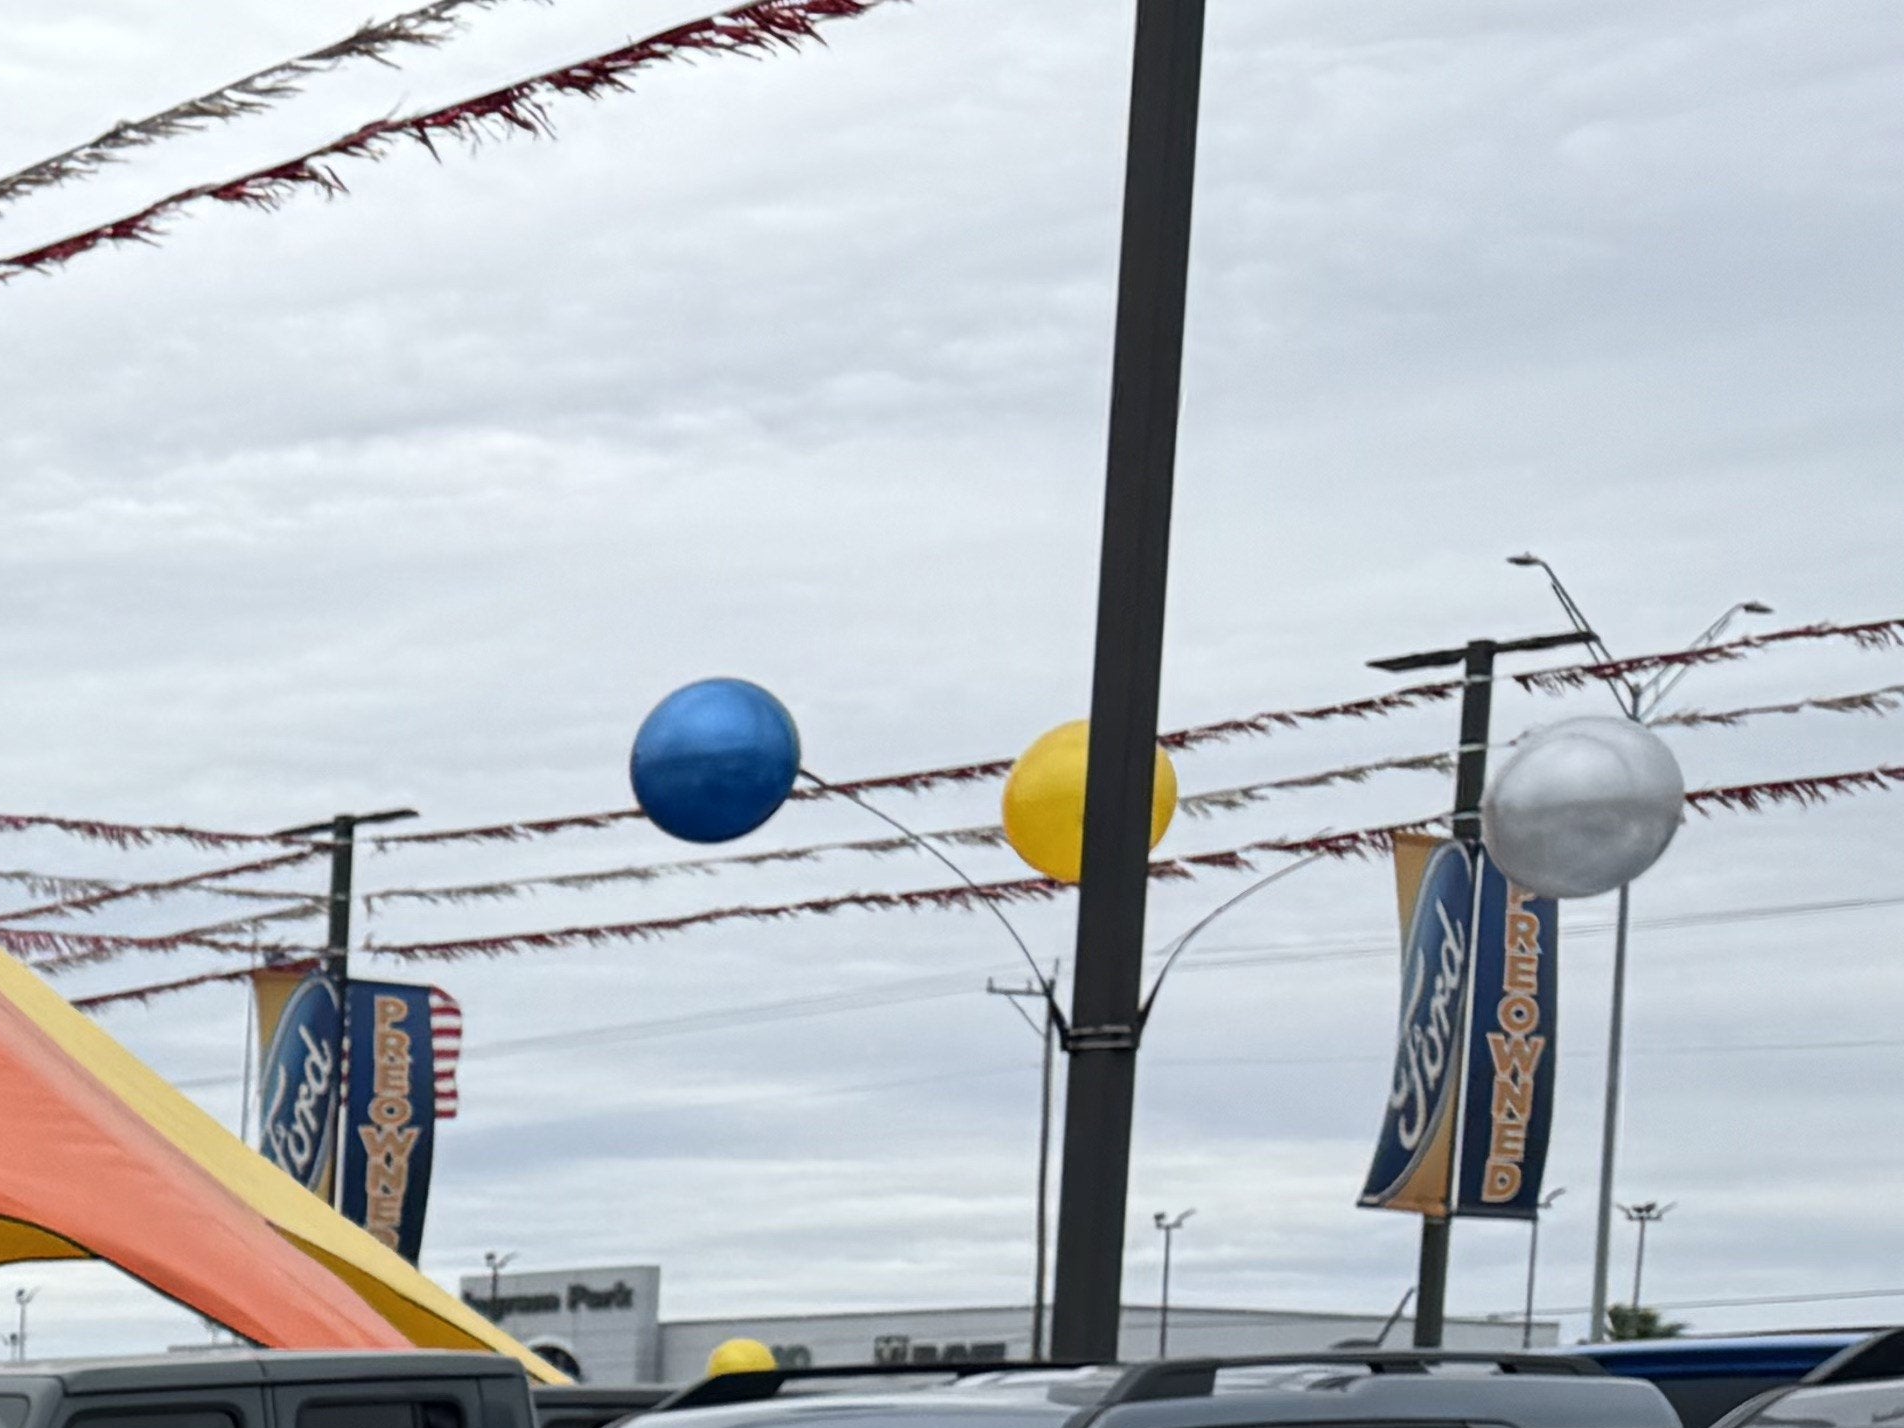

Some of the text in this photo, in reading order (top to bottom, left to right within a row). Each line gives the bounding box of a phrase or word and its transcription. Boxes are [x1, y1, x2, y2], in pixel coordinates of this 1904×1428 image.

[265, 1024, 333, 1178] Ford
[1392, 898, 1466, 1151] Ford
[567, 1280, 633, 1313] Park
